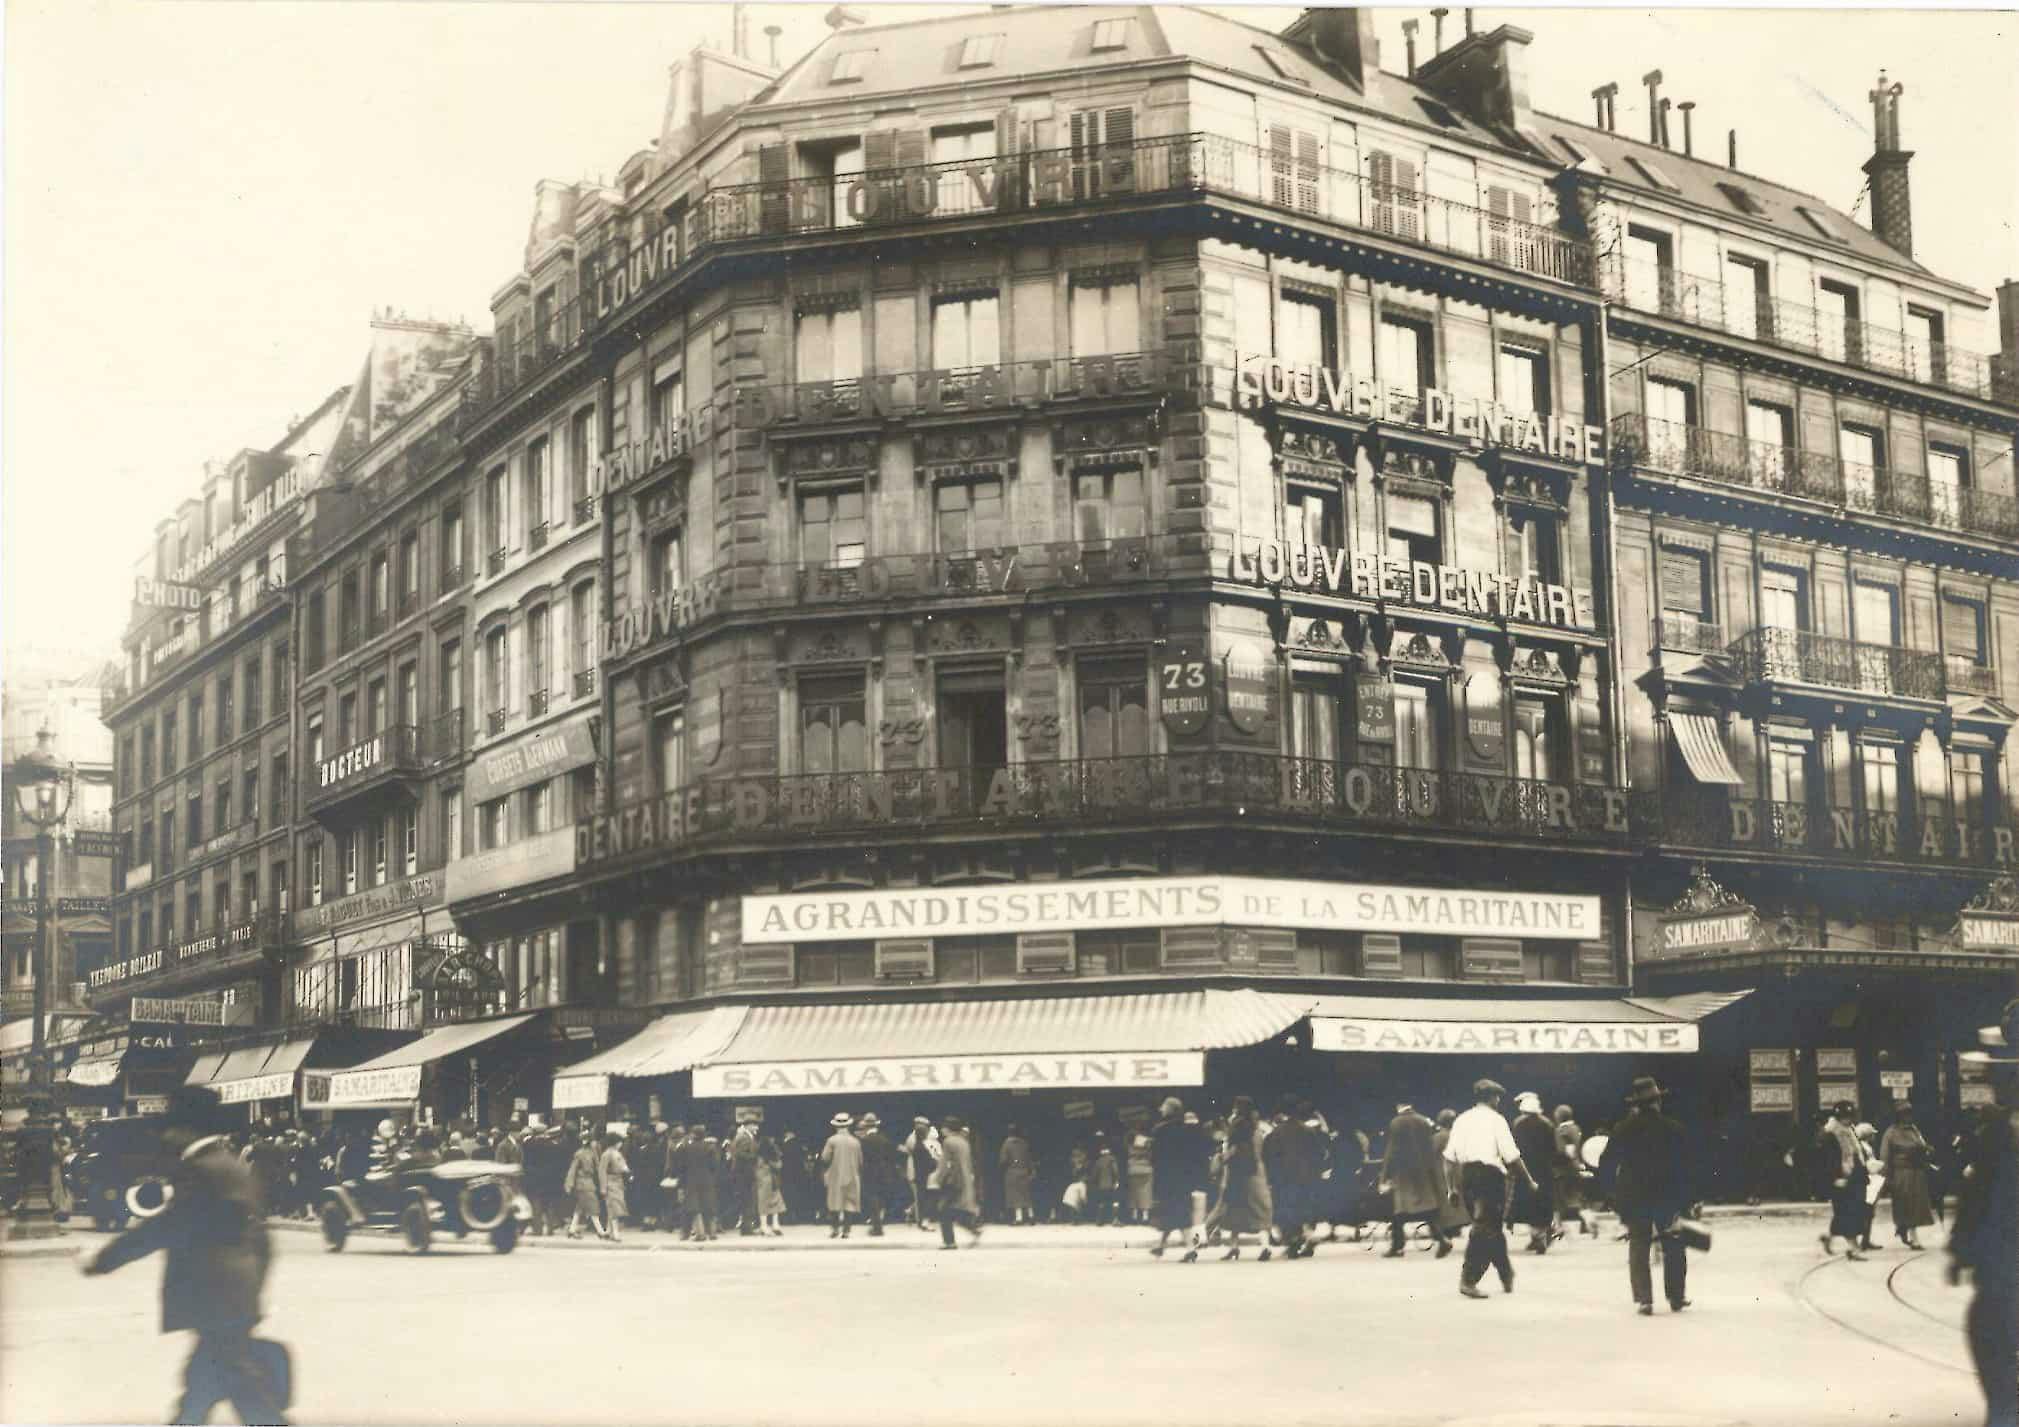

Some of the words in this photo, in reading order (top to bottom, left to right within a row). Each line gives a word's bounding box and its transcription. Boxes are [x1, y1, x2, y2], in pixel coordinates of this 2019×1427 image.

[787, 142, 1130, 226] LOUVRE
[596, 207, 699, 319] LOUVRE
[592, 405, 714, 500] DENTAIRE
[1425, 387, 1604, 466] DENTAIRE
[1233, 533, 1403, 598] LOUVRE
[1413, 561, 1595, 630] DENTAIRE
[603, 573, 722, 662] LOUVRE
[1163, 662, 1206, 689] 73
[1366, 704, 1384, 720] 73
[321, 738, 380, 787] DOCTEUR
[577, 790, 698, 864] DENTAIRE
[1276, 764, 1630, 832] LOUVRE
[761, 885, 1222, 933] AGRANDISSEMENTS
[1244, 895, 1283, 917] DE
[1302, 897, 1338, 918] LA
[1357, 892, 1585, 930] SAMARITAINE
[1665, 916, 1750, 948] SAMARITAINE
[1341, 1025, 1681, 1050] SAMARITAINE
[721, 1058, 1170, 1092] SAMARITAINE
